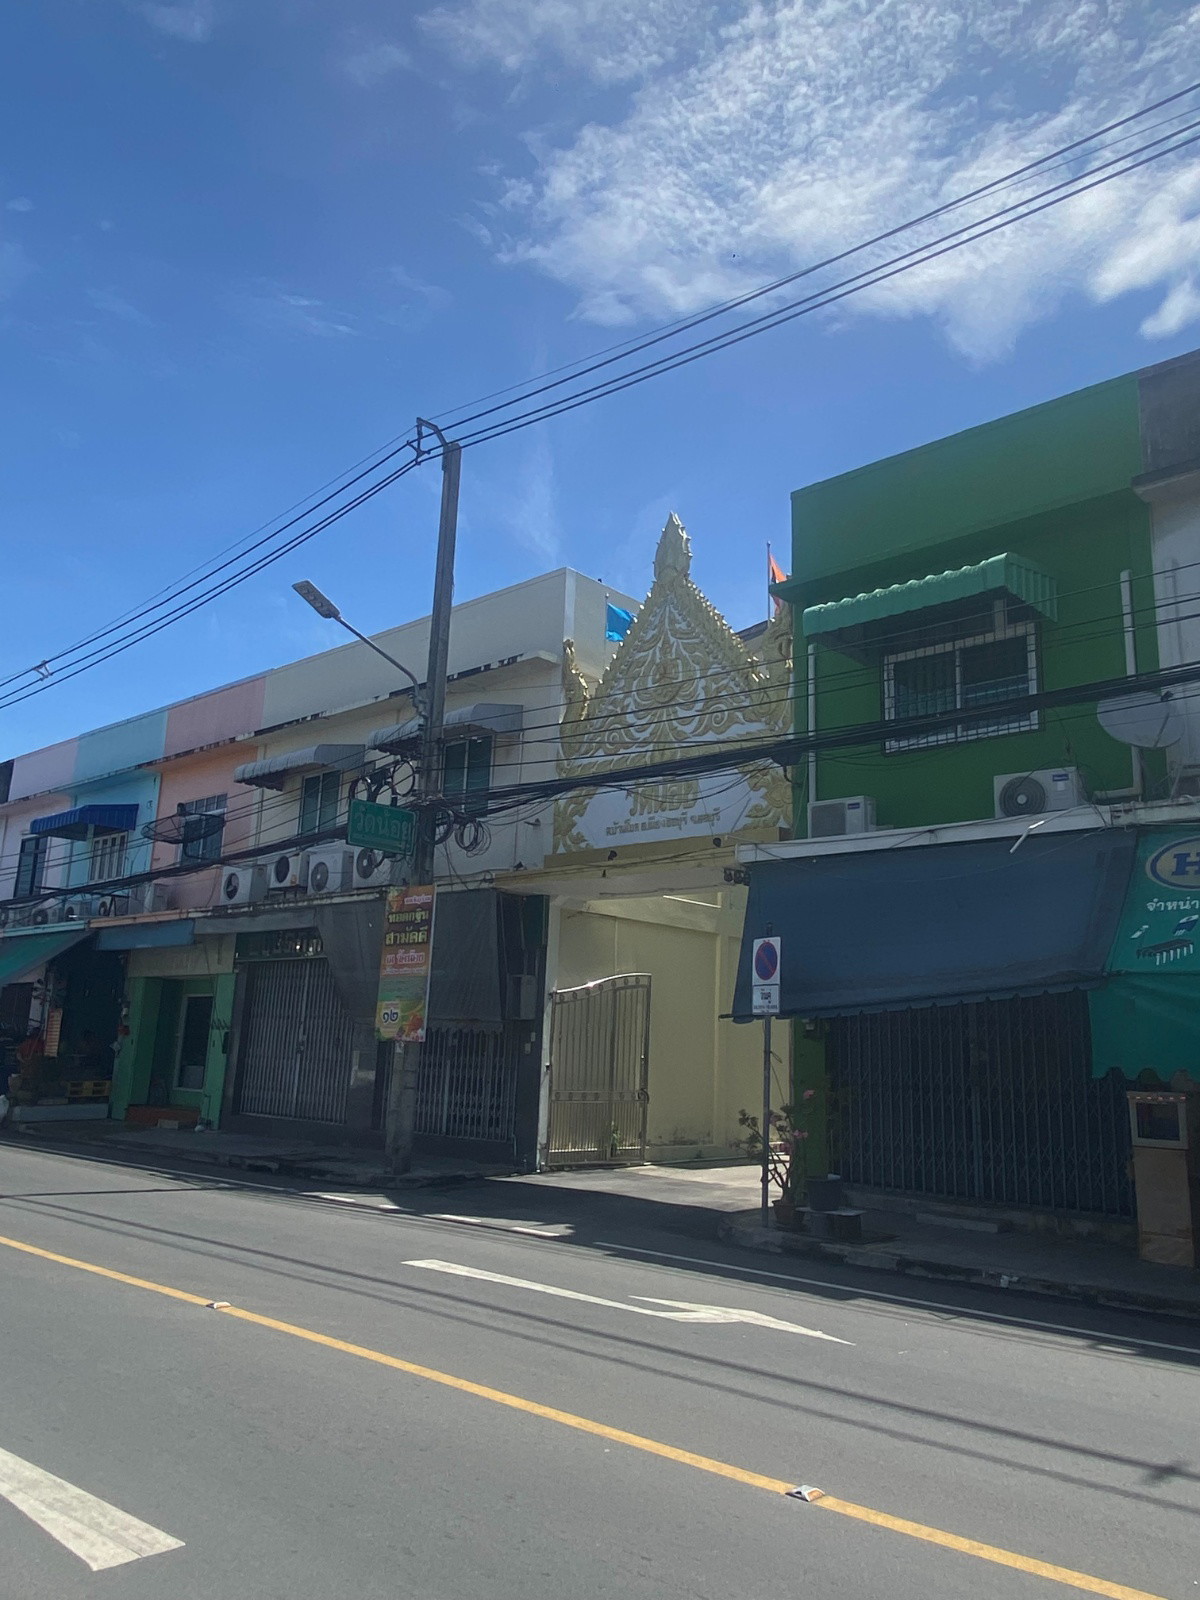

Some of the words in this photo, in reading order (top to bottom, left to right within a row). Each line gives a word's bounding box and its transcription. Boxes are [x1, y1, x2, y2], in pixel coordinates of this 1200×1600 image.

[354, 804, 412, 841] วัดน้อย
[387, 907, 429, 924] ทอดกฐิน
[385, 926, 428, 945] สามัคคี
